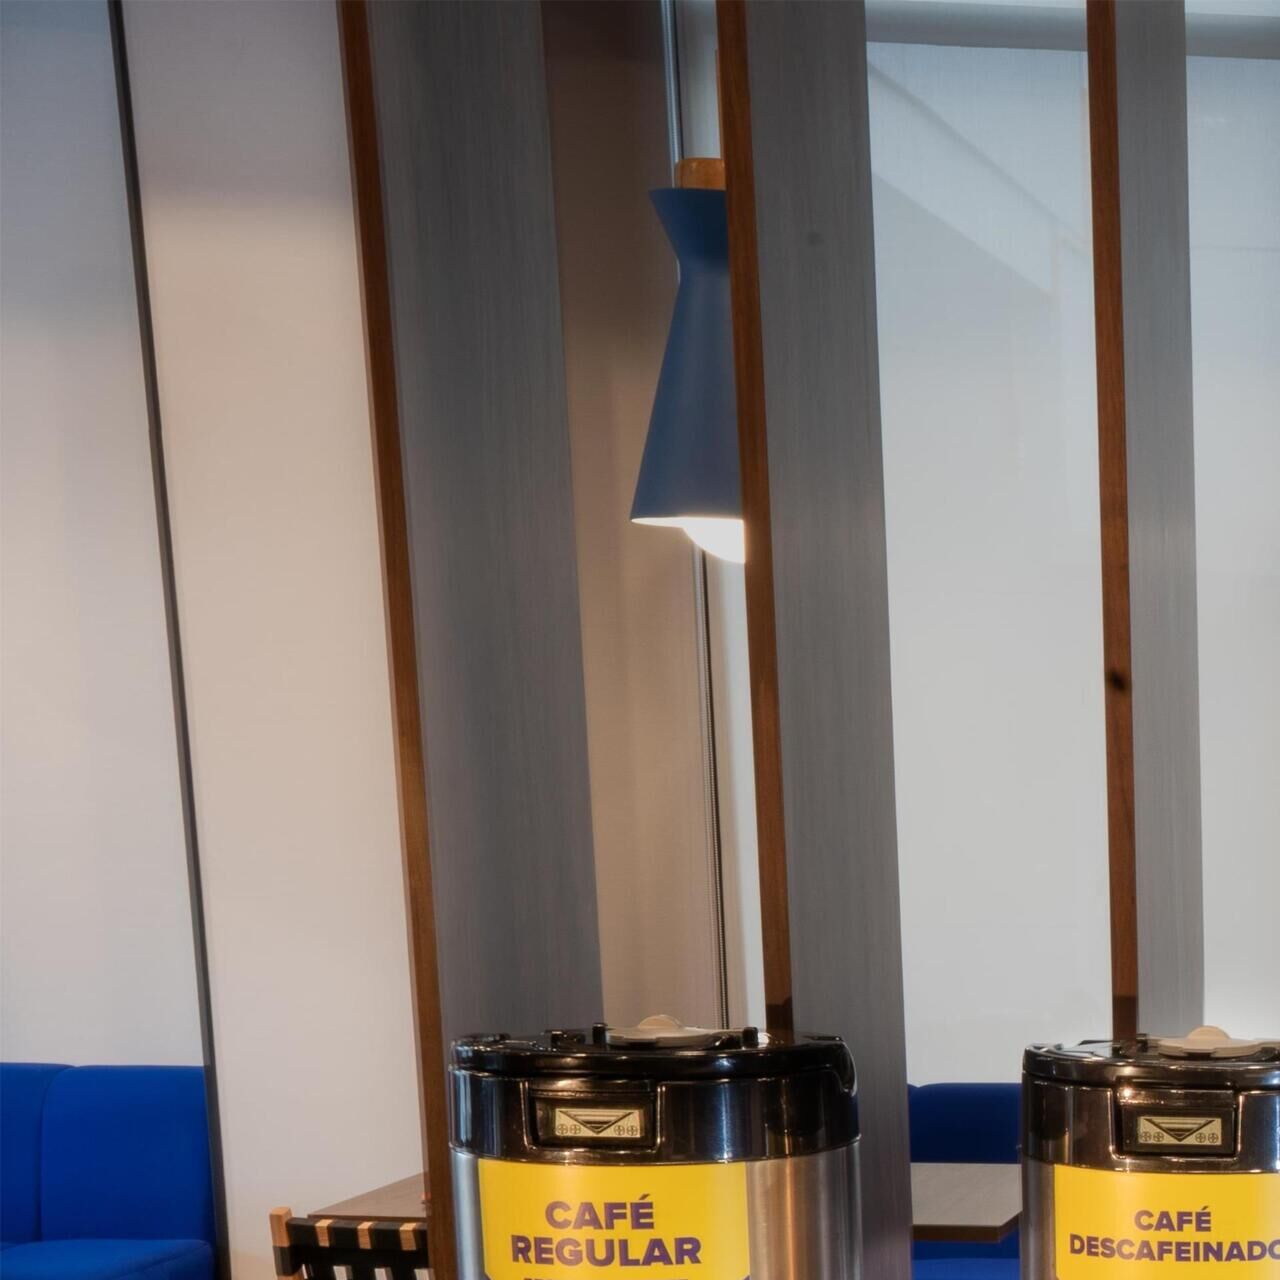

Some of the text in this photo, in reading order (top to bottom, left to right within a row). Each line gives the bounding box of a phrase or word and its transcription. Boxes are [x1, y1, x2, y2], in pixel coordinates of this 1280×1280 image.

[545, 1193, 654, 1230] CAFÉ
[1134, 1205, 1212, 1232] CAFÉ
[511, 1234, 702, 1267] REGULAR
